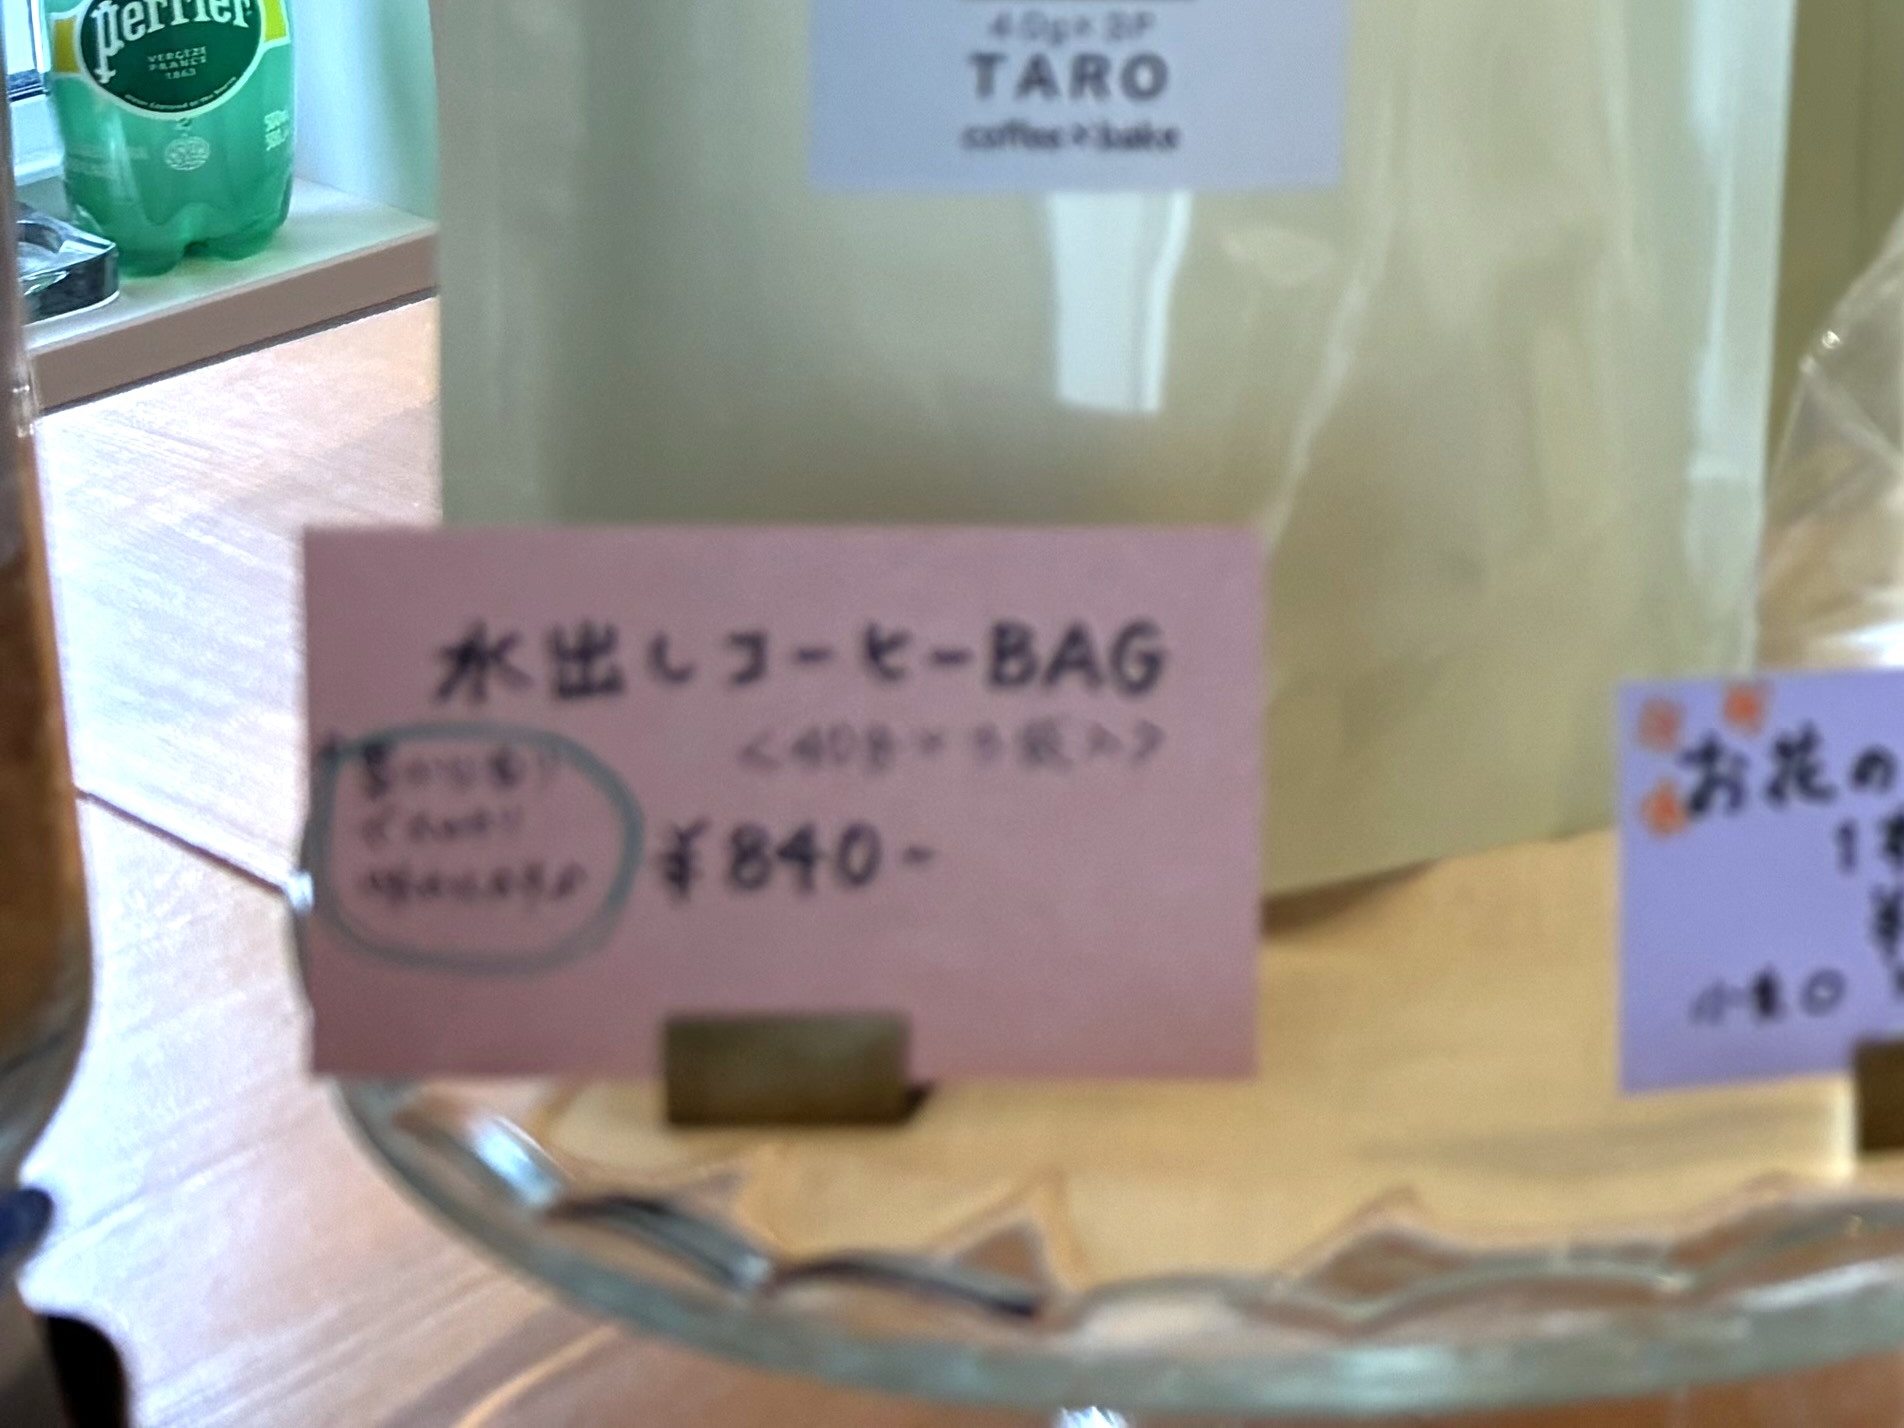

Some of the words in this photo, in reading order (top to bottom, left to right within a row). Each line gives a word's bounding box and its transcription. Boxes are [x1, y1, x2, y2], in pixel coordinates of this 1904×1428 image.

[968, 52, 1170, 101] TARO
[431, 616, 1167, 704] 水出しコーヒーBAG
